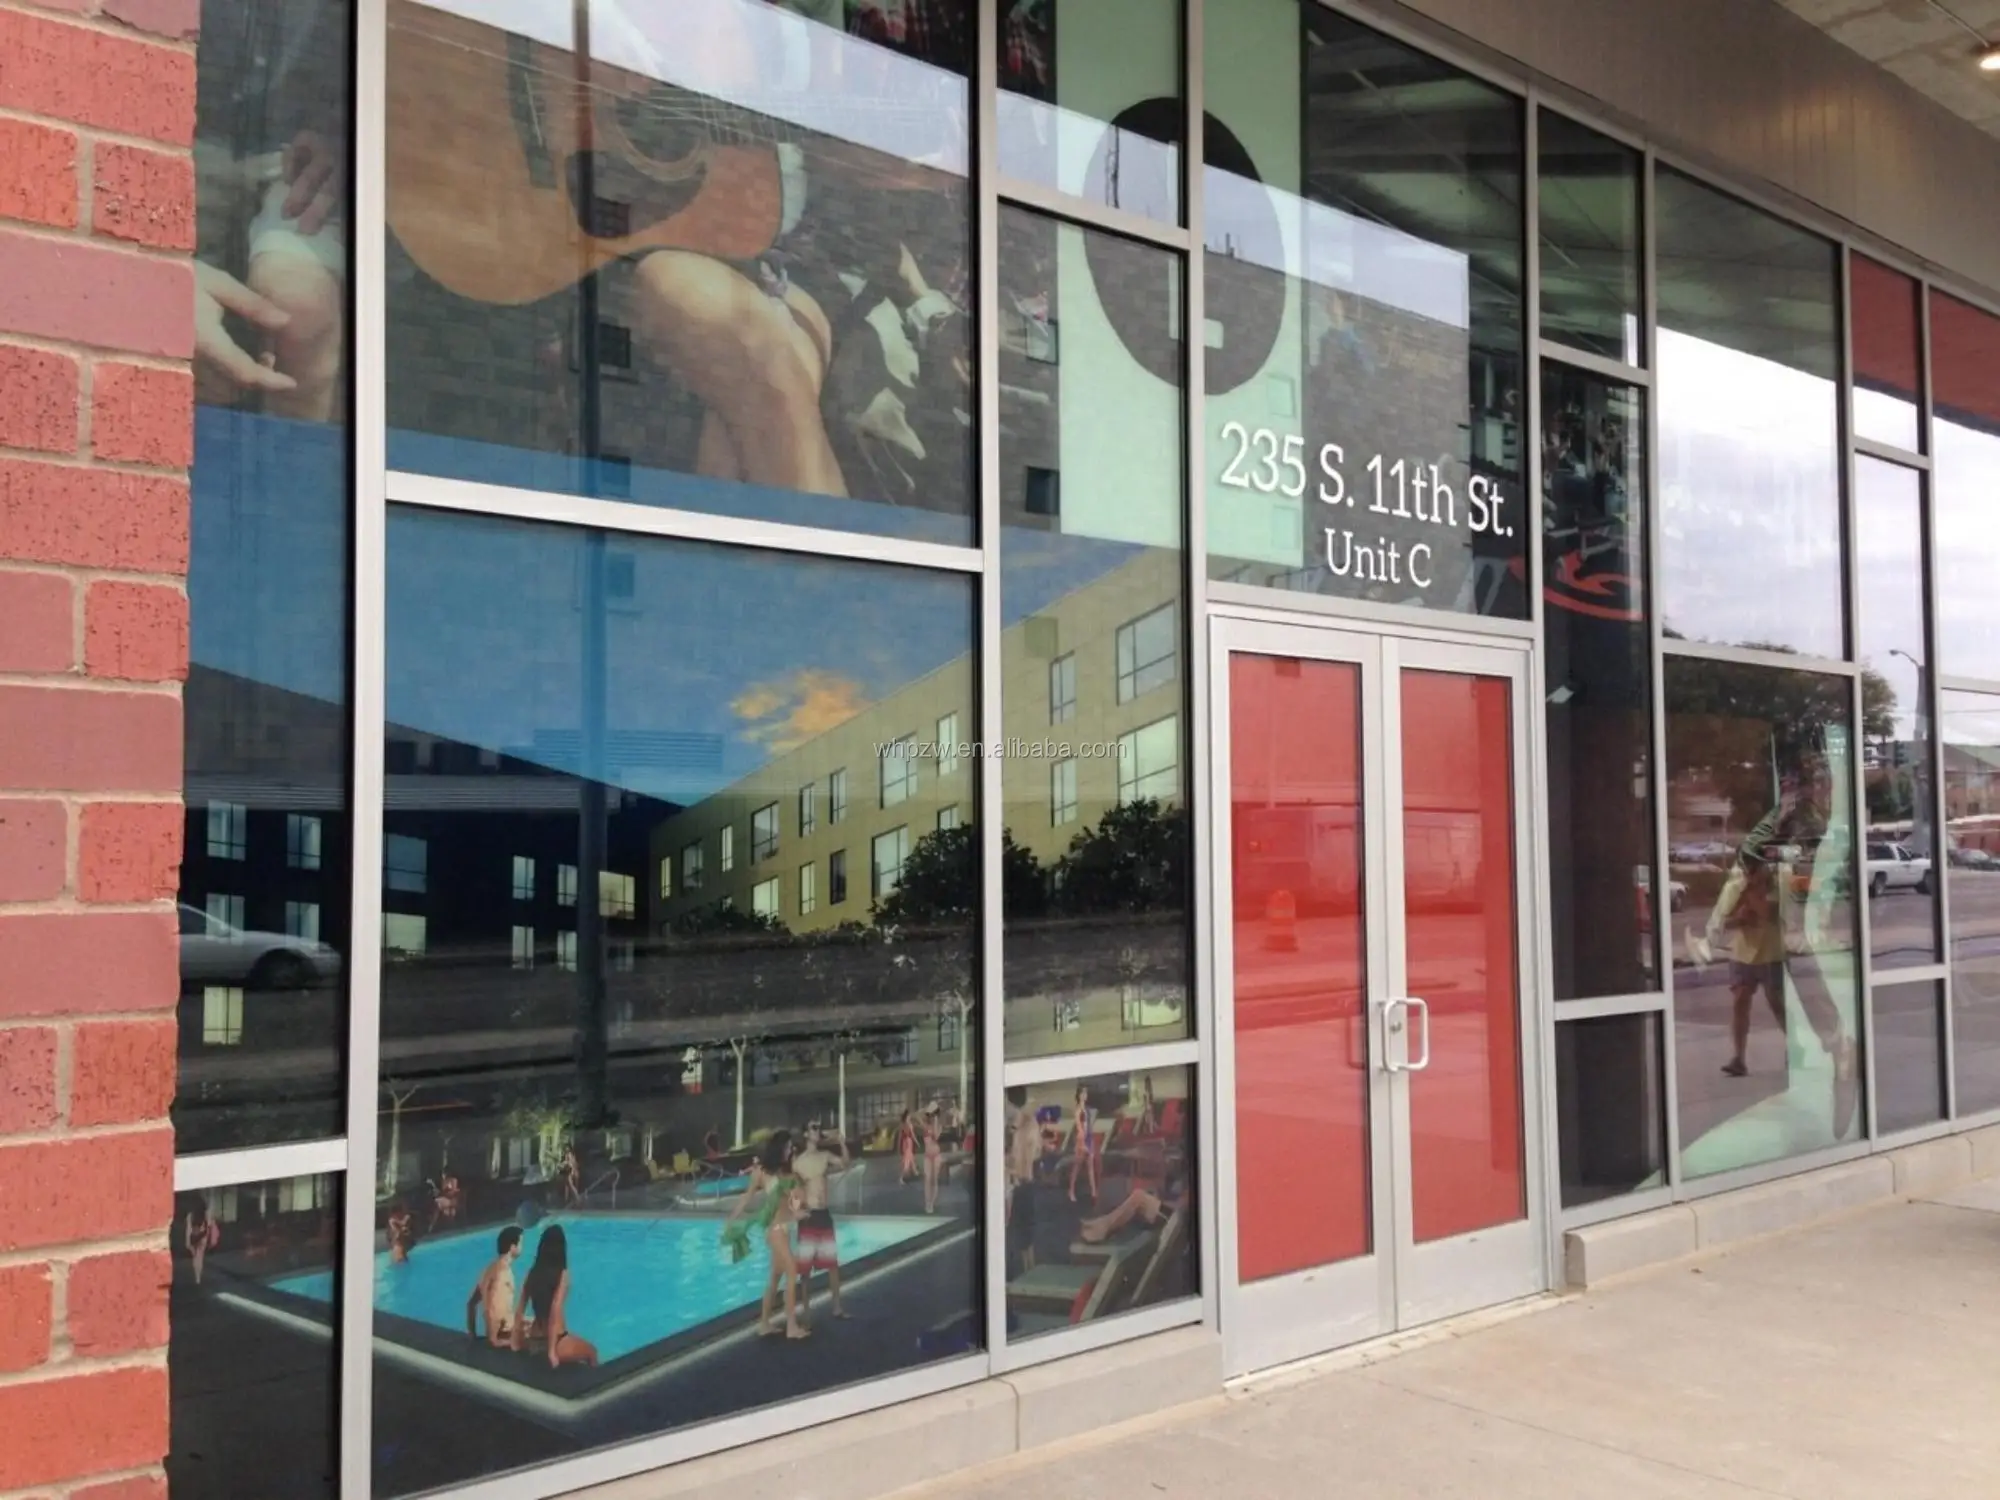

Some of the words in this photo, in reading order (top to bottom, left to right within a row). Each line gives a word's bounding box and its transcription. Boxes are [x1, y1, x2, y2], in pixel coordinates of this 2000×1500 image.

[1220, 421, 1306, 497] 235
[1319, 443, 1354, 508] S.
[1366, 454, 1457, 526] 11th
[1468, 475, 1514, 537] St.
[1324, 528, 1400, 583] Unit
[1409, 543, 1432, 588] C
